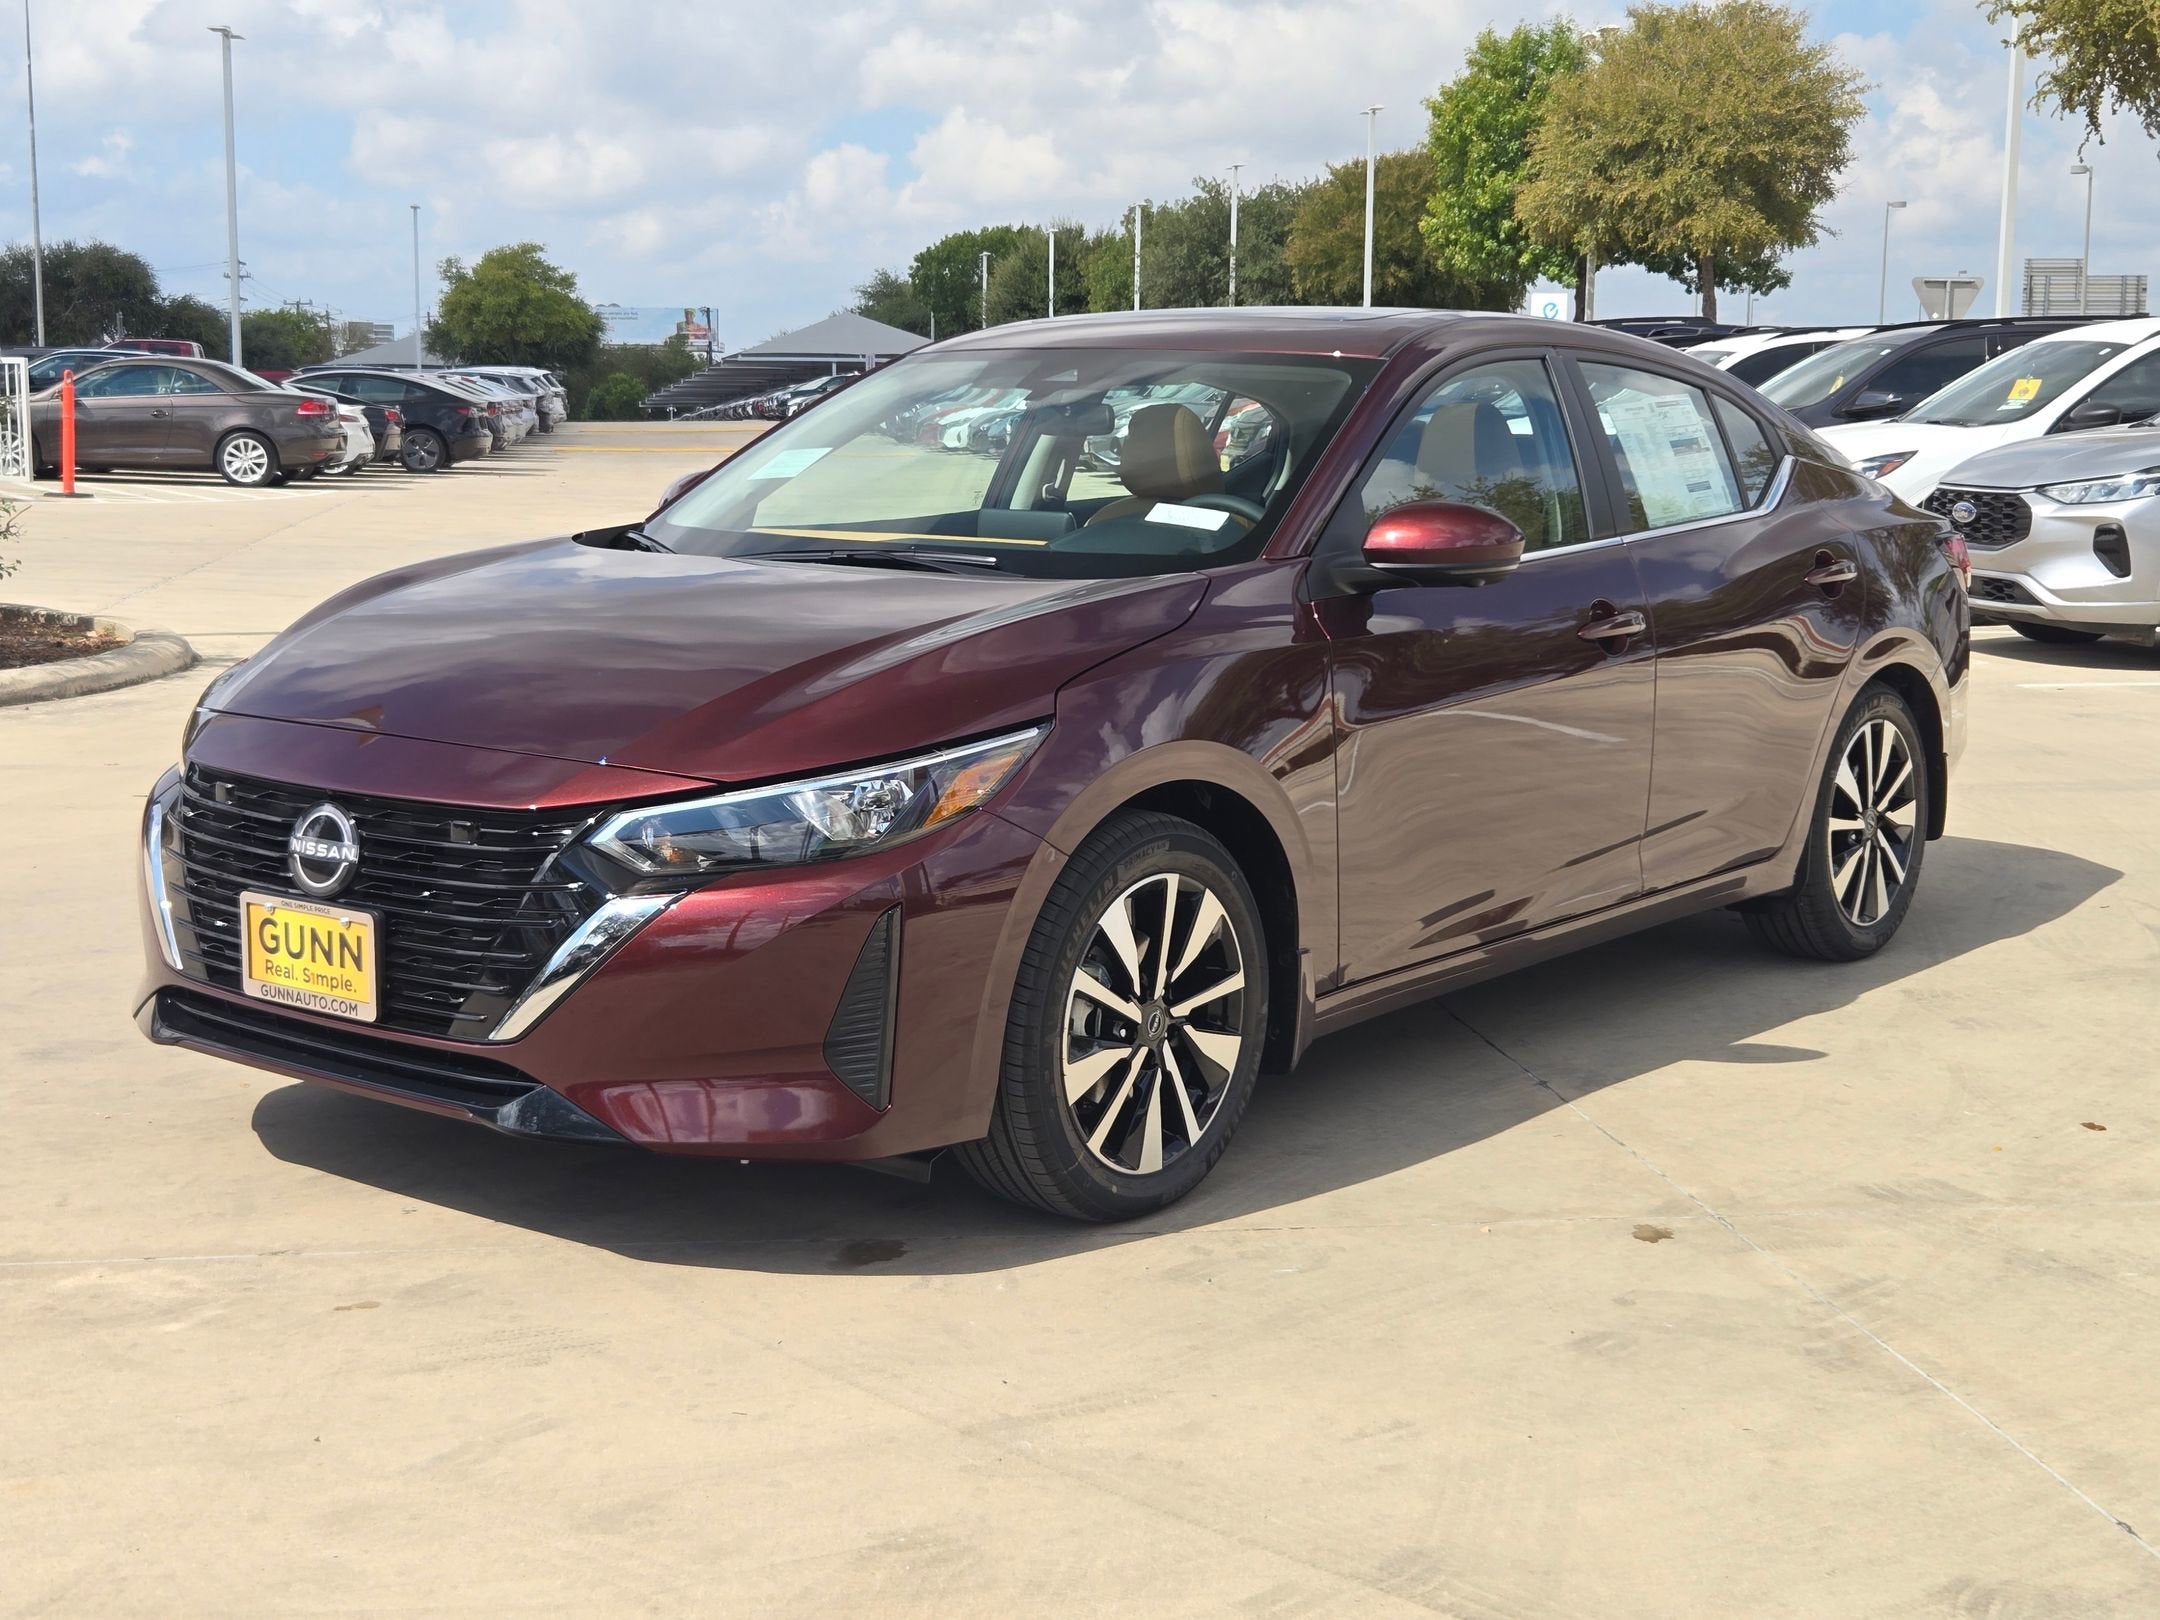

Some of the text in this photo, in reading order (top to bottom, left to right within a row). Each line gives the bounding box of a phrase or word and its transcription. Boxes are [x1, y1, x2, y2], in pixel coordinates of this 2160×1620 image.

[291, 838, 357, 863] NISSAN
[259, 917, 363, 972] GUNN
[265, 959, 357, 993] Real. Simple.
[261, 984, 358, 1017] GUNNAUTO.COM
